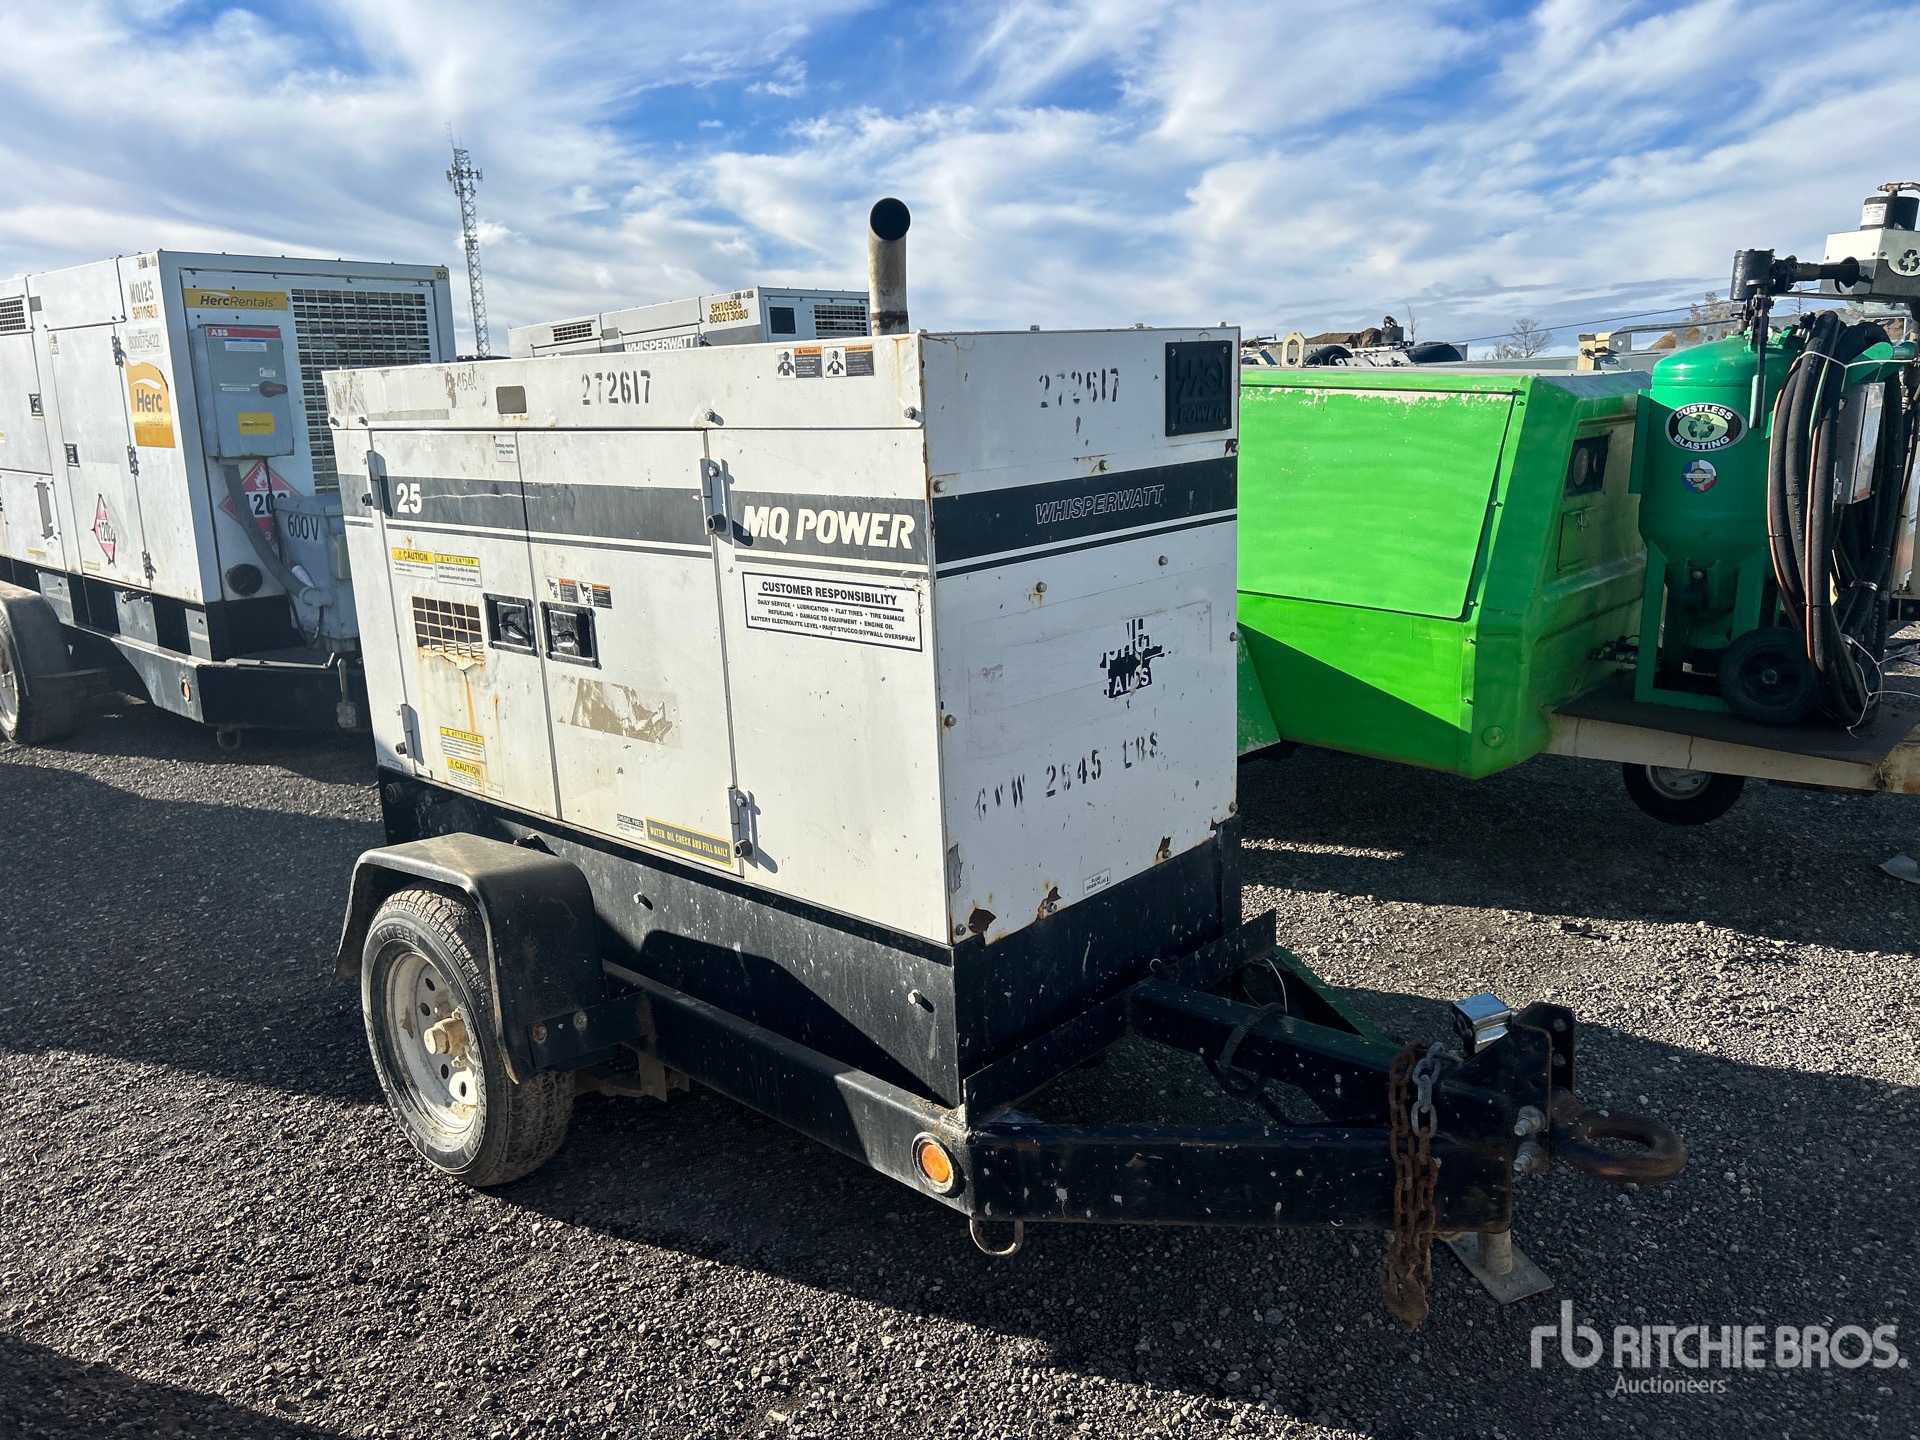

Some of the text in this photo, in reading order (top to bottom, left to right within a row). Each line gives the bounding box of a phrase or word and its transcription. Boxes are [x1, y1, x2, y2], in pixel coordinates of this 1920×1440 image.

[707, 308, 750, 325] 800213080
[709, 299, 743, 315] SH10586
[210, 328, 229, 337] ABB
[624, 334, 697, 353] WHISPERWATT
[581, 369, 652, 406] 272617
[136, 389, 163, 413] Herc
[1675, 404, 1734, 420] DUSTLESS
[1673, 434, 1730, 450] BLASTING
[396, 482, 423, 514] 25
[1035, 484, 1165, 525] WHISPERWATT
[264, 531, 272, 540] 3
[742, 504, 916, 550] MQ POWER
[403, 550, 429, 562] CAUTION
[446, 556, 475, 565] ATTENTION
[762, 581, 897, 606] CUSTOMER RESPONSIBILITY
[767, 609, 794, 617] REFUELING
[800, 612, 820, 620] DAMAGE
[828, 617, 857, 626] EQUIPMENT
[863, 621, 884, 629] ENGINE
[884, 622, 894, 630] OIL
[796, 603, 829, 613] LUBRICATION
[882, 614, 905, 622] DAMAGE
[751, 615, 771, 623] BATTERY
[771, 617, 803, 627] ELECTROLYTE
[884, 632, 916, 642] OVERSPRAY
[454, 761, 481, 776] CAUTION
[667, 831, 675, 842] OIL
[675, 833, 692, 847] CHECK
[692, 838, 702, 850] AND
[702, 842, 714, 854] FILL
[714, 846, 728, 858] DAILY
